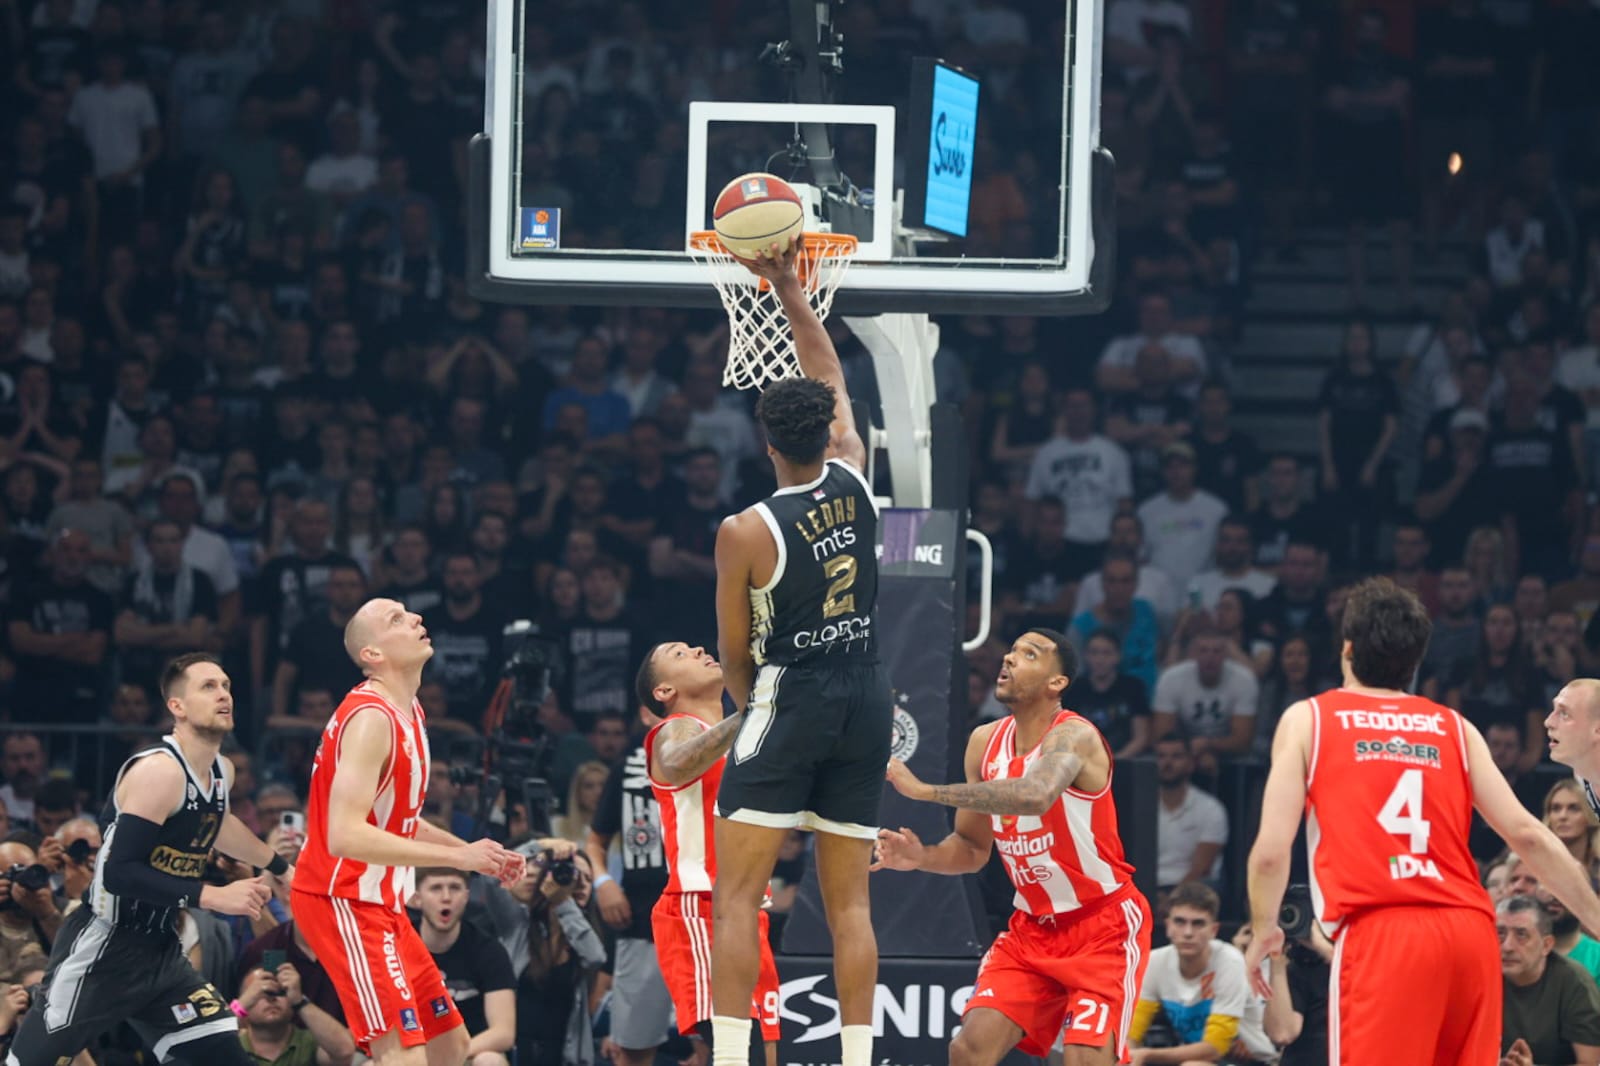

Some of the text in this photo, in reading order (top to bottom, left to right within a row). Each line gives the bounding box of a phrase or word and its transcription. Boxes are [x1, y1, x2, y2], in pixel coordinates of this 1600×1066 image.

[795, 495, 856, 543] LEDAY
[812, 526, 856, 561] mts
[823, 554, 858, 619] 2
[1334, 710, 1447, 736] TEODOSIĆ
[1355, 740, 1440, 761] SOCCER
[1376, 769, 1431, 854] 4
[383, 931, 411, 1001] carnex
[764, 990, 779, 1025] 9
[1072, 998, 1109, 1034] 21
